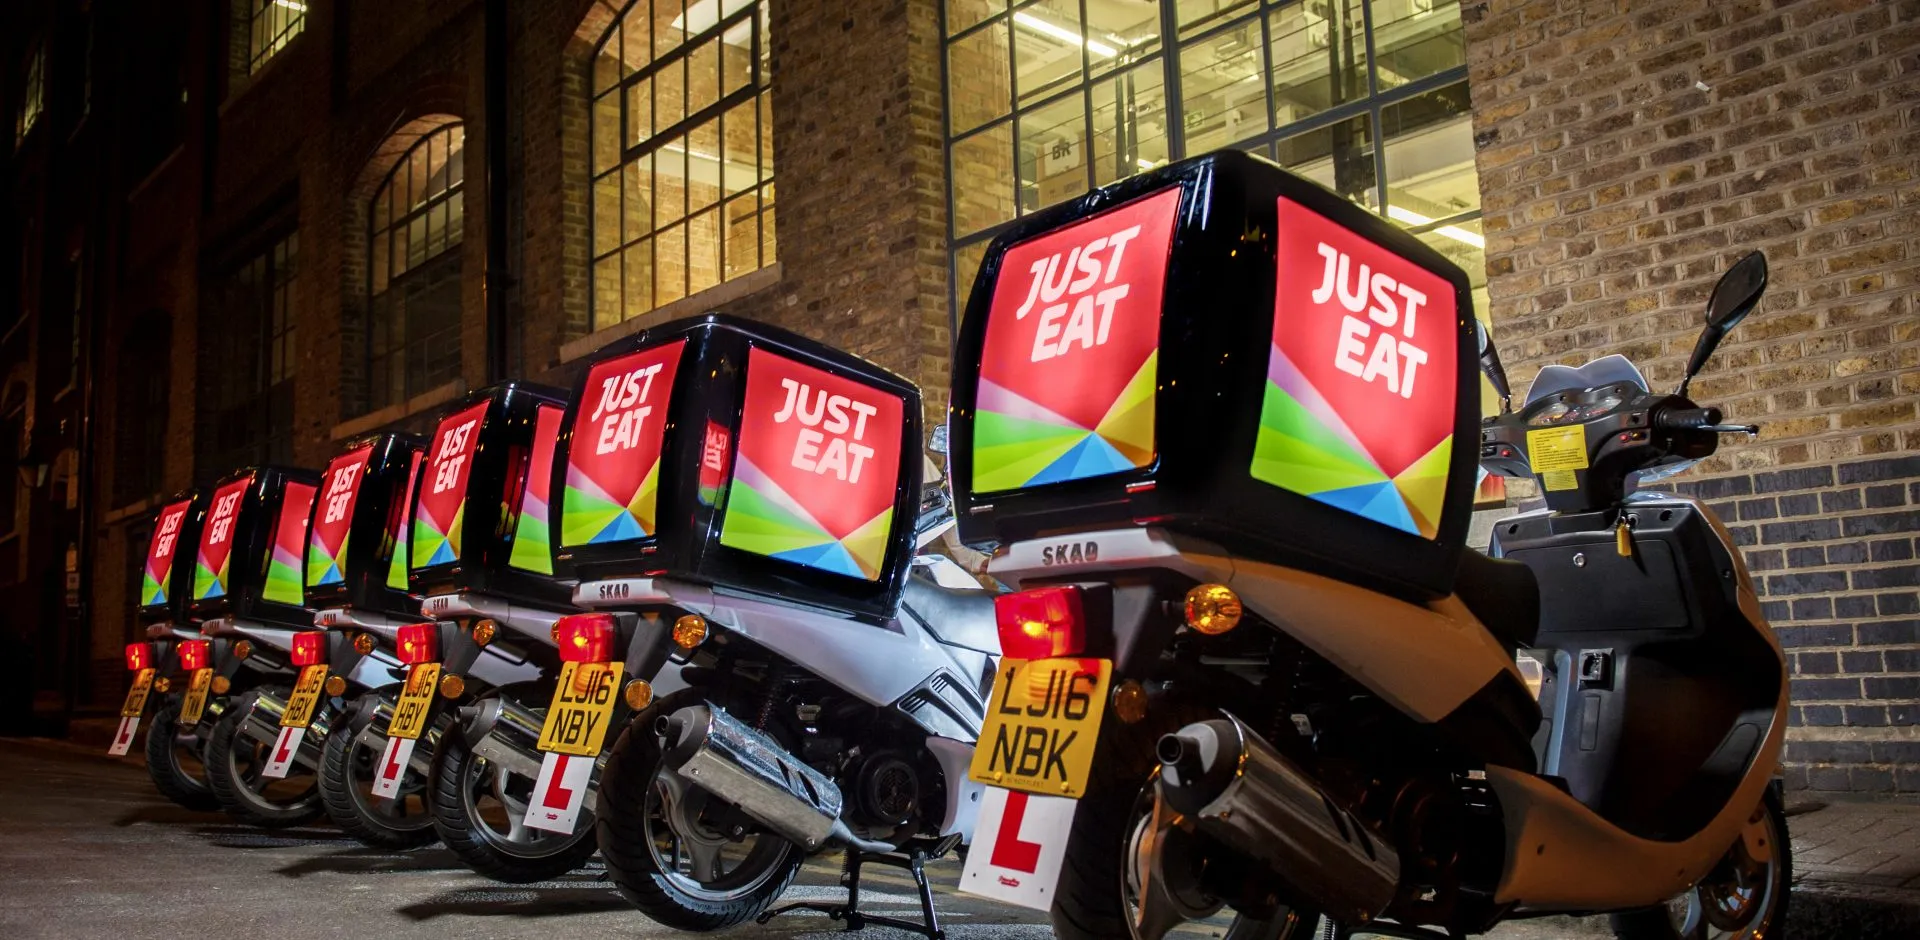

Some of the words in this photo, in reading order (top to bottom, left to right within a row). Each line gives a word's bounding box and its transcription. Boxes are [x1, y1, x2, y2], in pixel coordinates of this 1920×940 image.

[1017, 225, 1141, 320] JUST
[1311, 242, 1428, 338] JUST
[1031, 284, 1129, 363] EAT
[1333, 315, 1428, 399] EAT
[591, 363, 662, 423] JUST
[774, 378, 877, 440] JUST
[434, 419, 477, 467] JUST
[596, 405, 652, 455] EAT
[433, 454, 466, 494] EAT
[791, 428, 875, 484] EAT
[326, 461, 362, 500] JUST
[157, 511, 184, 539] JUST
[210, 490, 240, 524] JUST
[325, 491, 352, 524] EAT
[209, 517, 233, 545] EAT
[1042, 541, 1099, 566] SKAD
[599, 583, 629, 600] SKAD
[286, 697, 313, 722] HBX
[560, 668, 614, 705] LJ16
[1000, 666, 1097, 721] LJ16
[394, 702, 424, 732] HBY
[549, 708, 602, 747] NBY
[382, 737, 400, 781] L
[989, 722, 1078, 782] NBK
[543, 755, 573, 811] L
[990, 790, 1042, 875] L
